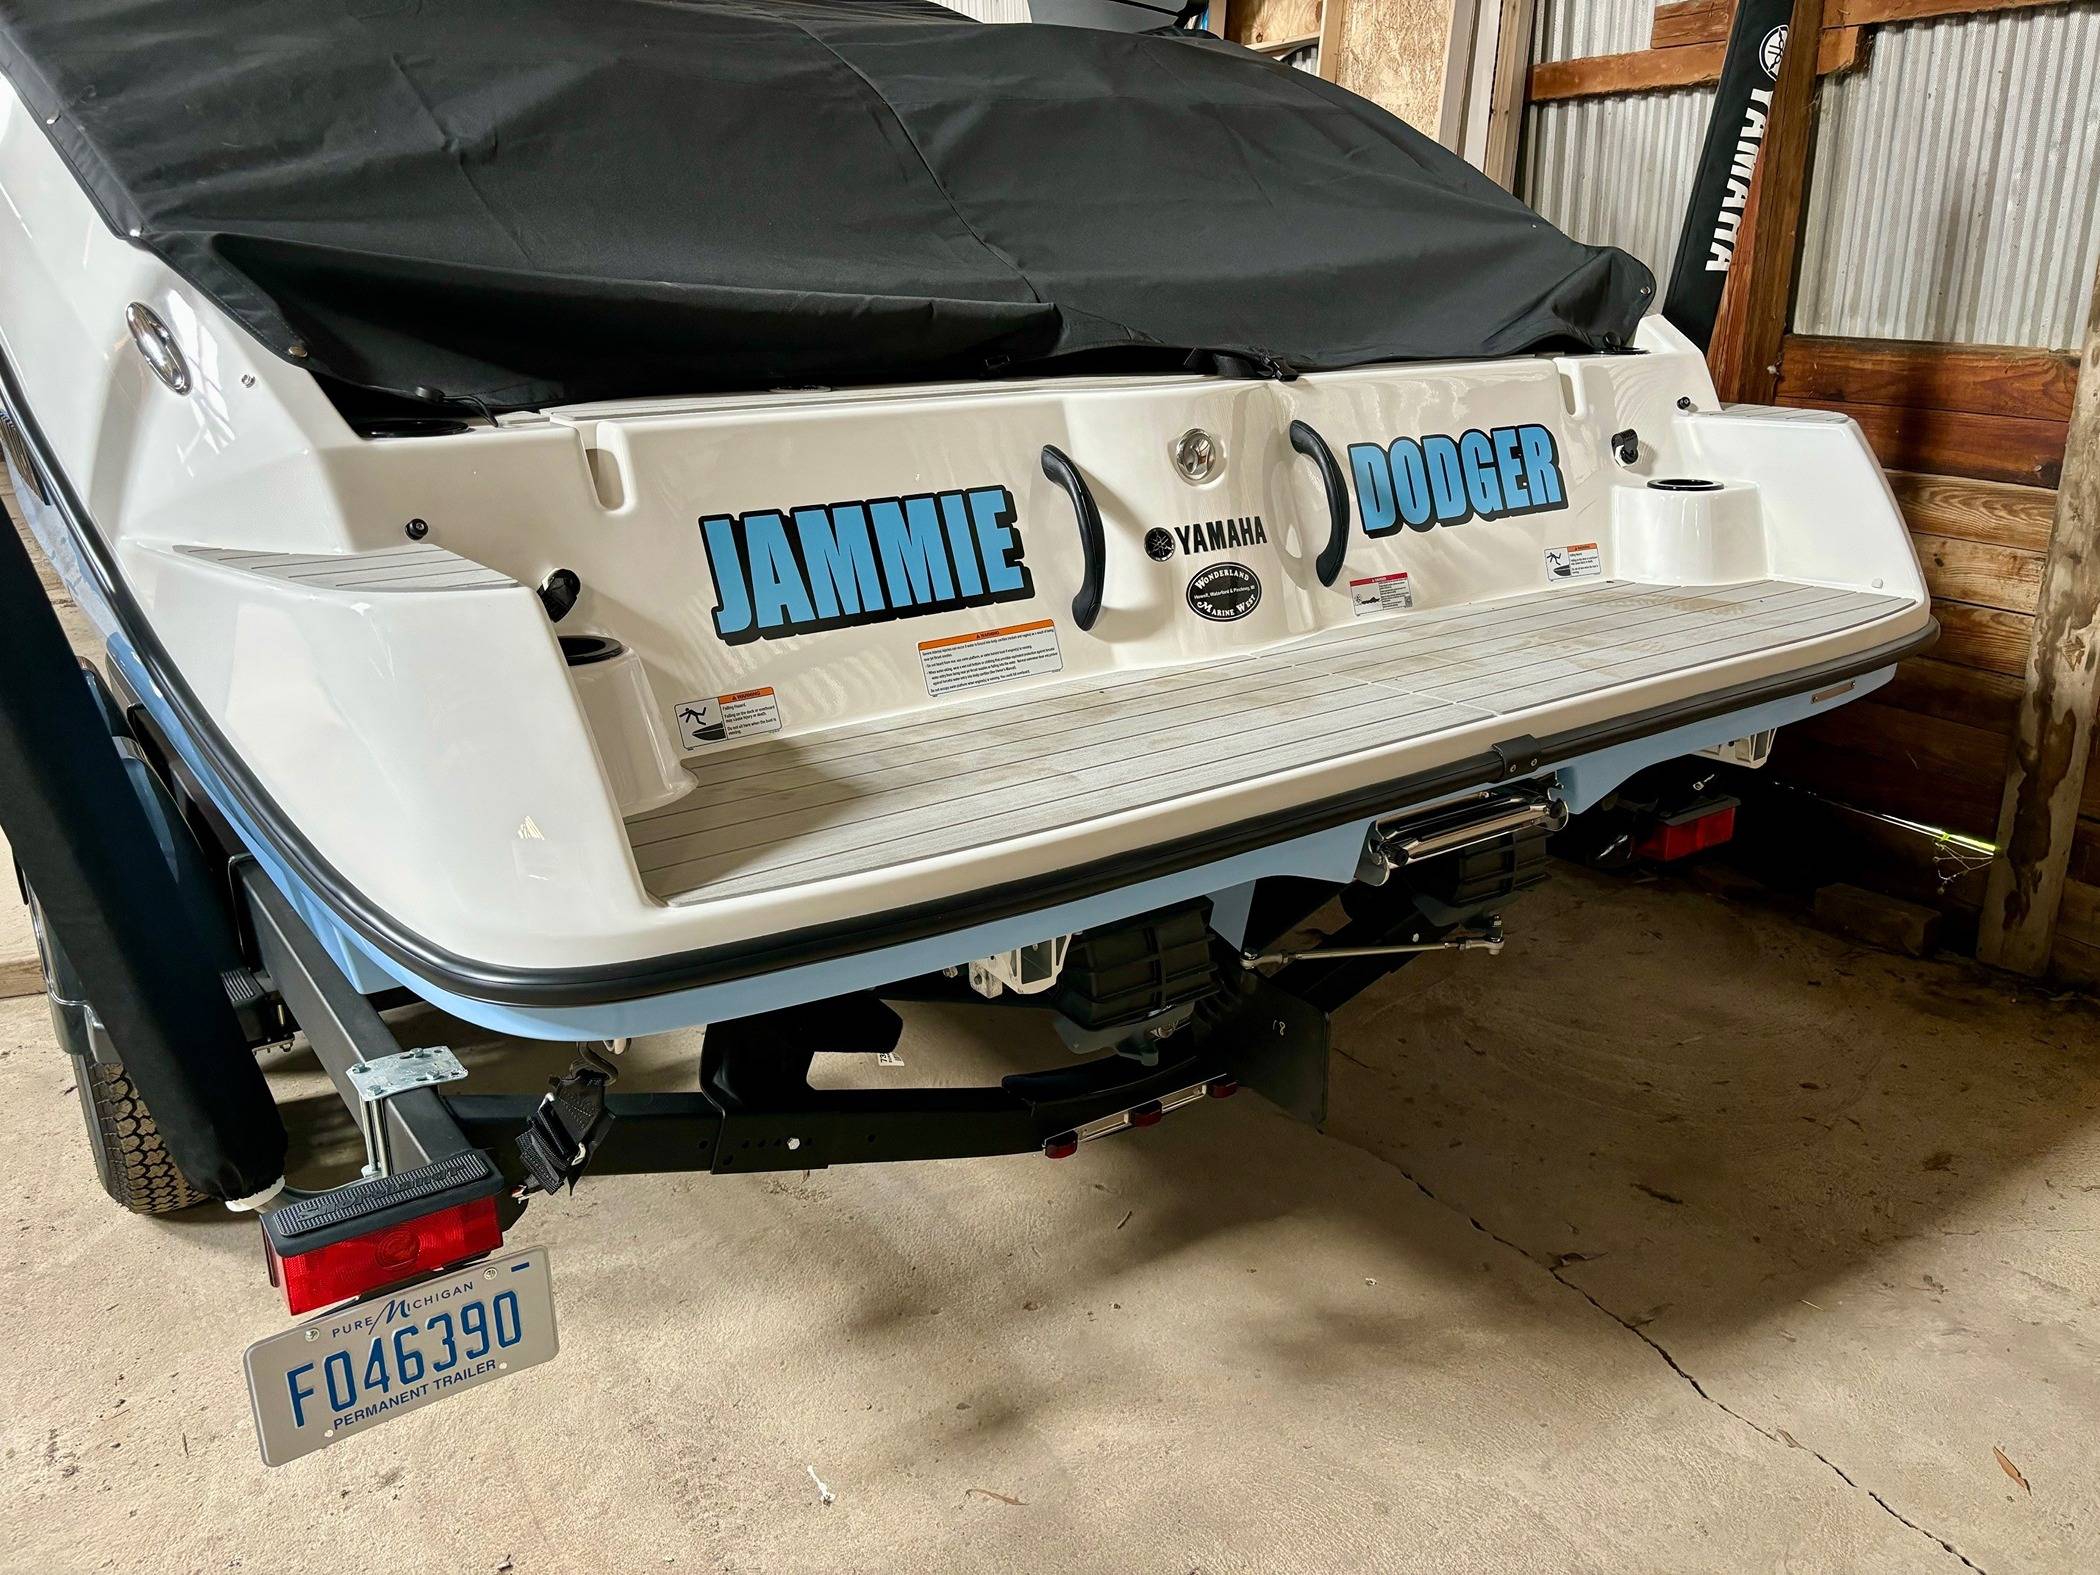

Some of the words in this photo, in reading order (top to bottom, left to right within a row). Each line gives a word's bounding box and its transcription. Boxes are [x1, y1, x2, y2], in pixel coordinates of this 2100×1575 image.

[1348, 424, 1568, 538] DODGER
[700, 486, 1033, 643] JAMMIE
[1174, 516, 1267, 555] YAMAHA
[1194, 569, 1250, 590] WONDERLAND
[1196, 601, 1235, 617] MARINE
[1236, 593, 1256, 613] WEST
[332, 1316, 374, 1339] PURE
[369, 1281, 475, 1336] MICHIGAN
[286, 1290, 523, 1428] F046390
[333, 1384, 430, 1431] PERMANENT
[433, 1359, 497, 1391] TRAILER
